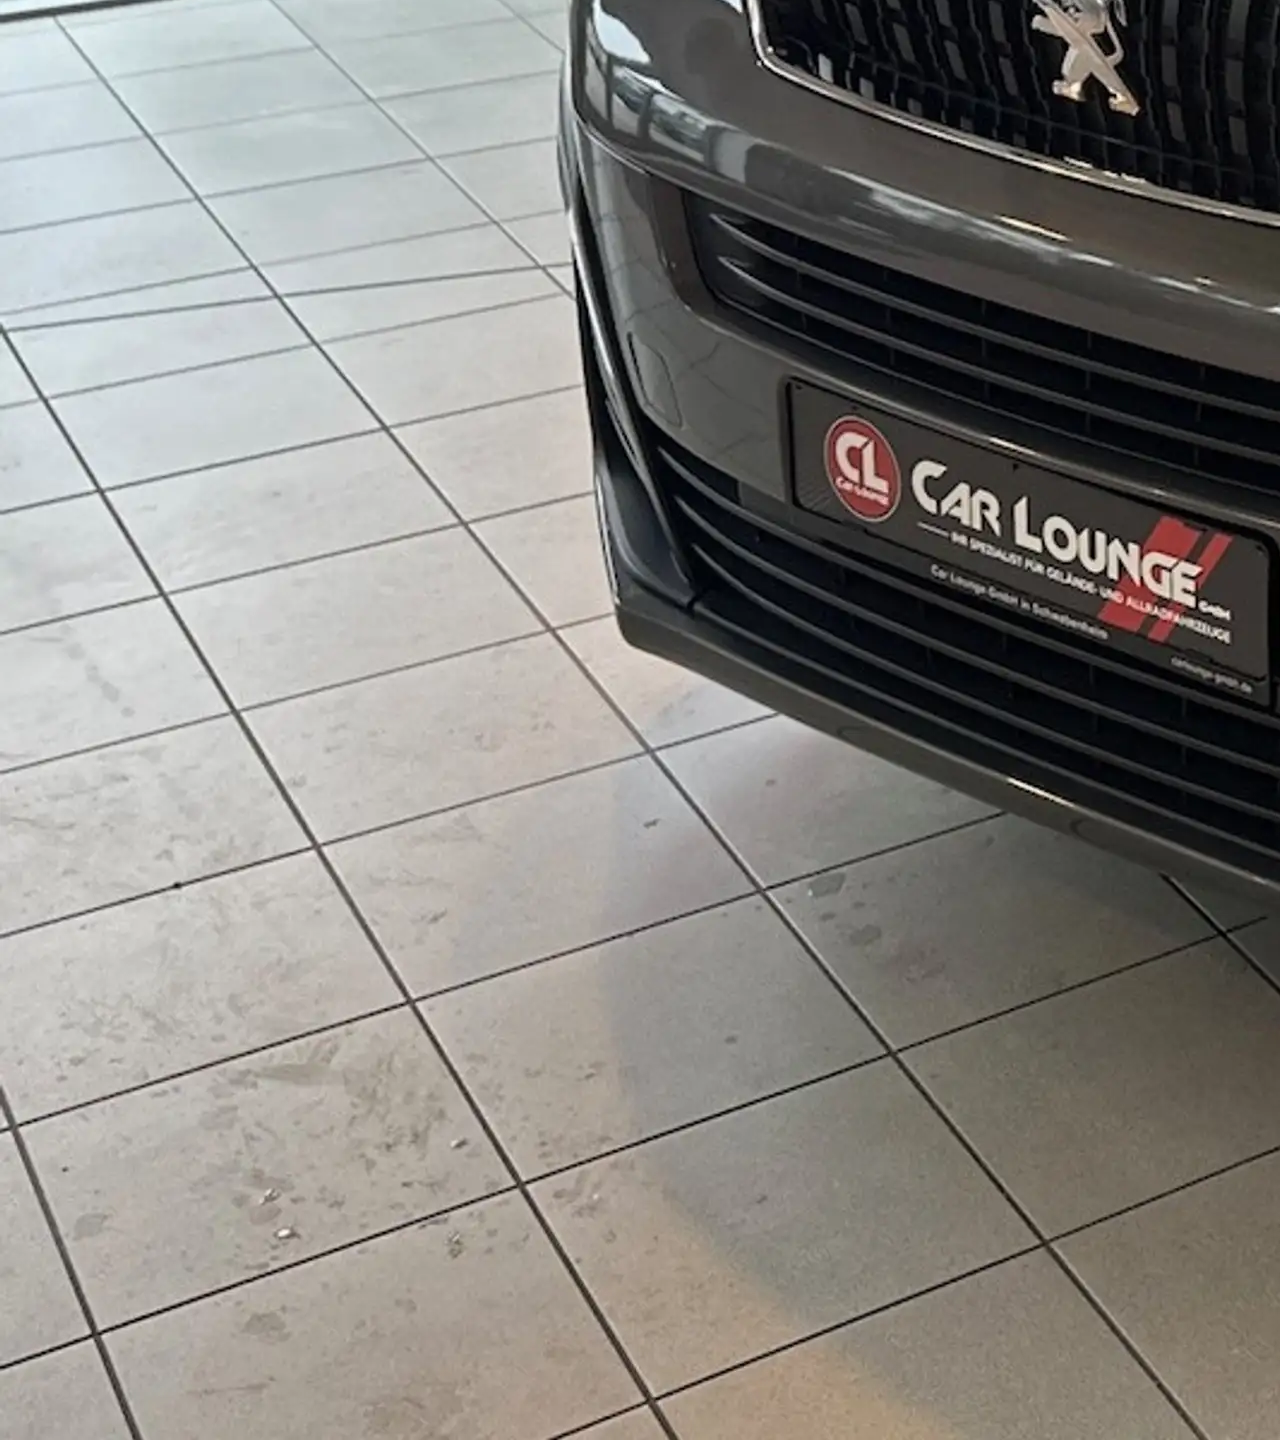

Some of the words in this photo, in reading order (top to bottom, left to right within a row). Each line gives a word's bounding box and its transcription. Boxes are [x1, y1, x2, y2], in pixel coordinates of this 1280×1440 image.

[835, 432, 890, 493] CL
[911, 459, 1002, 538] CAR
[1011, 495, 1205, 609] LOUNGE
[930, 563, 949, 581] Car
[950, 572, 987, 596] Lounge
[969, 537, 1024, 569] SPEZIALIST
[1023, 558, 1046, 576] FÜR
[1098, 585, 1125, 605] UND
[1124, 596, 1233, 646] ALLRADFAHRZEUGE
